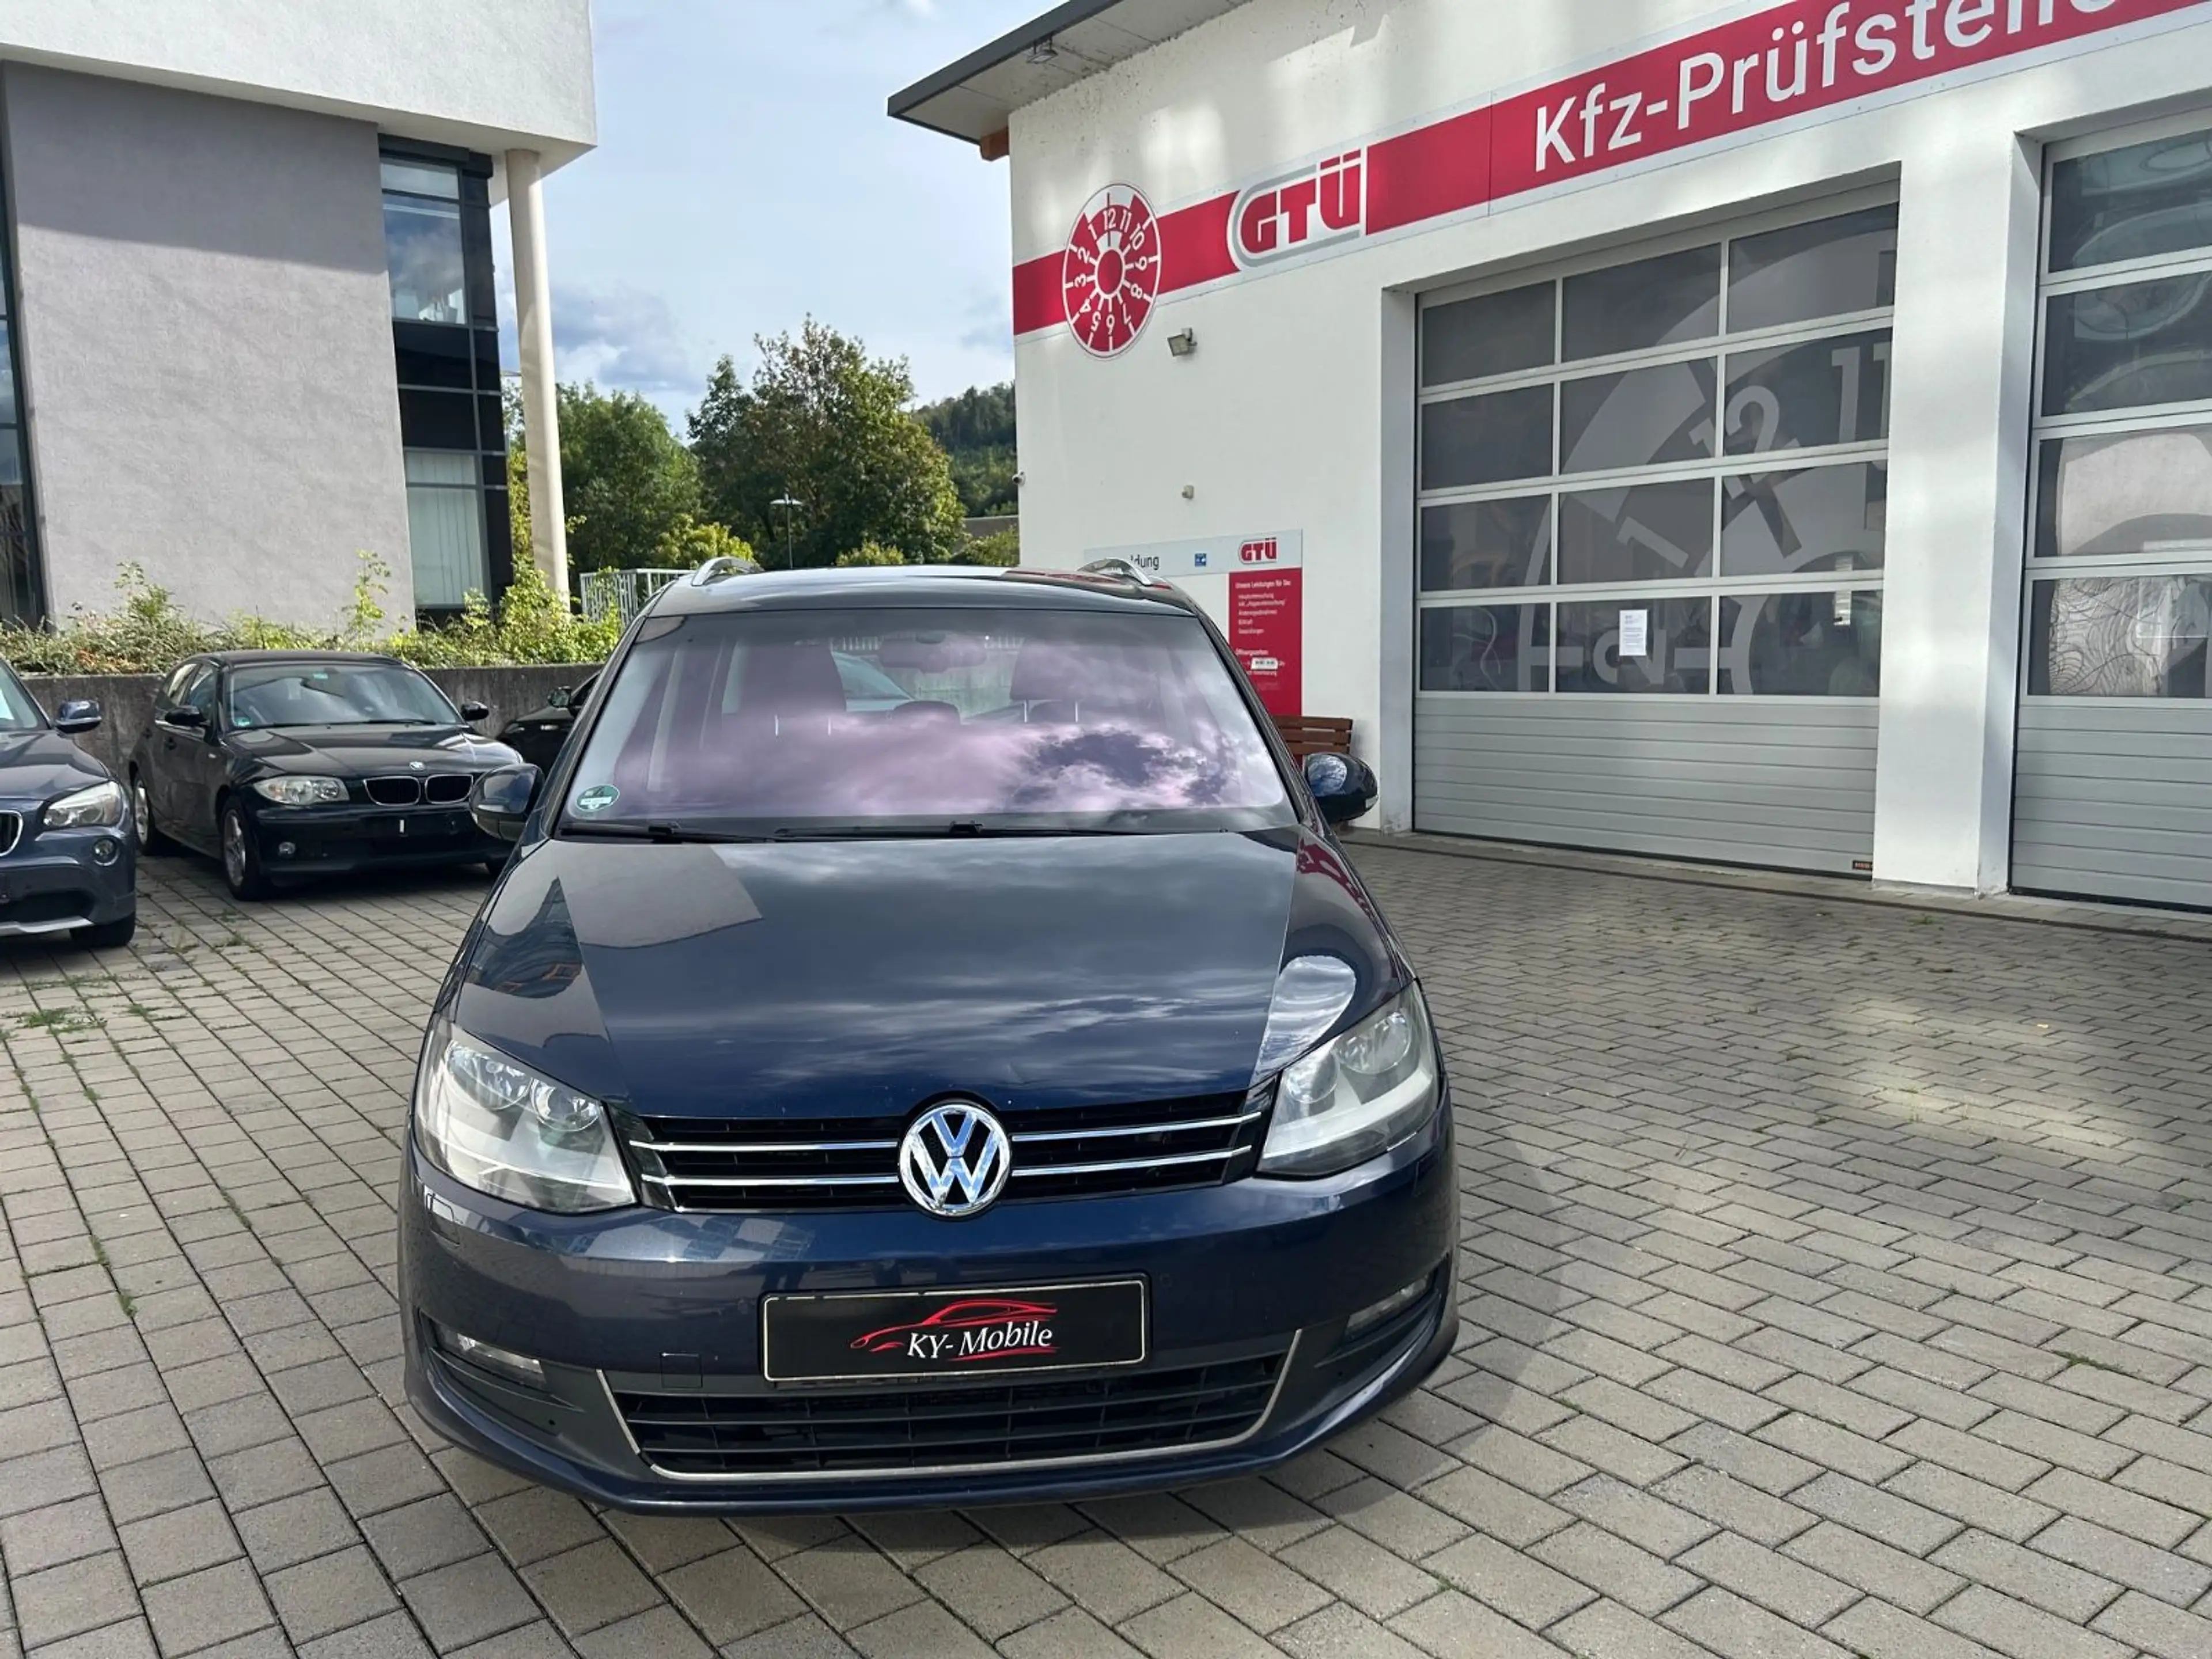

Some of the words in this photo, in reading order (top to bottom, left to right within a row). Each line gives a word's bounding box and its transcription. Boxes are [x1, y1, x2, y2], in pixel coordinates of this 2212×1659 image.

[1535, 0, 2116, 172] Kfz-Prüfste
[1240, 149, 1361, 254] GTÜ
[1103, 209, 1116, 230] 12
[1130, 223, 1145, 250] 10
[1240, 536, 1277, 561] GTÜ
